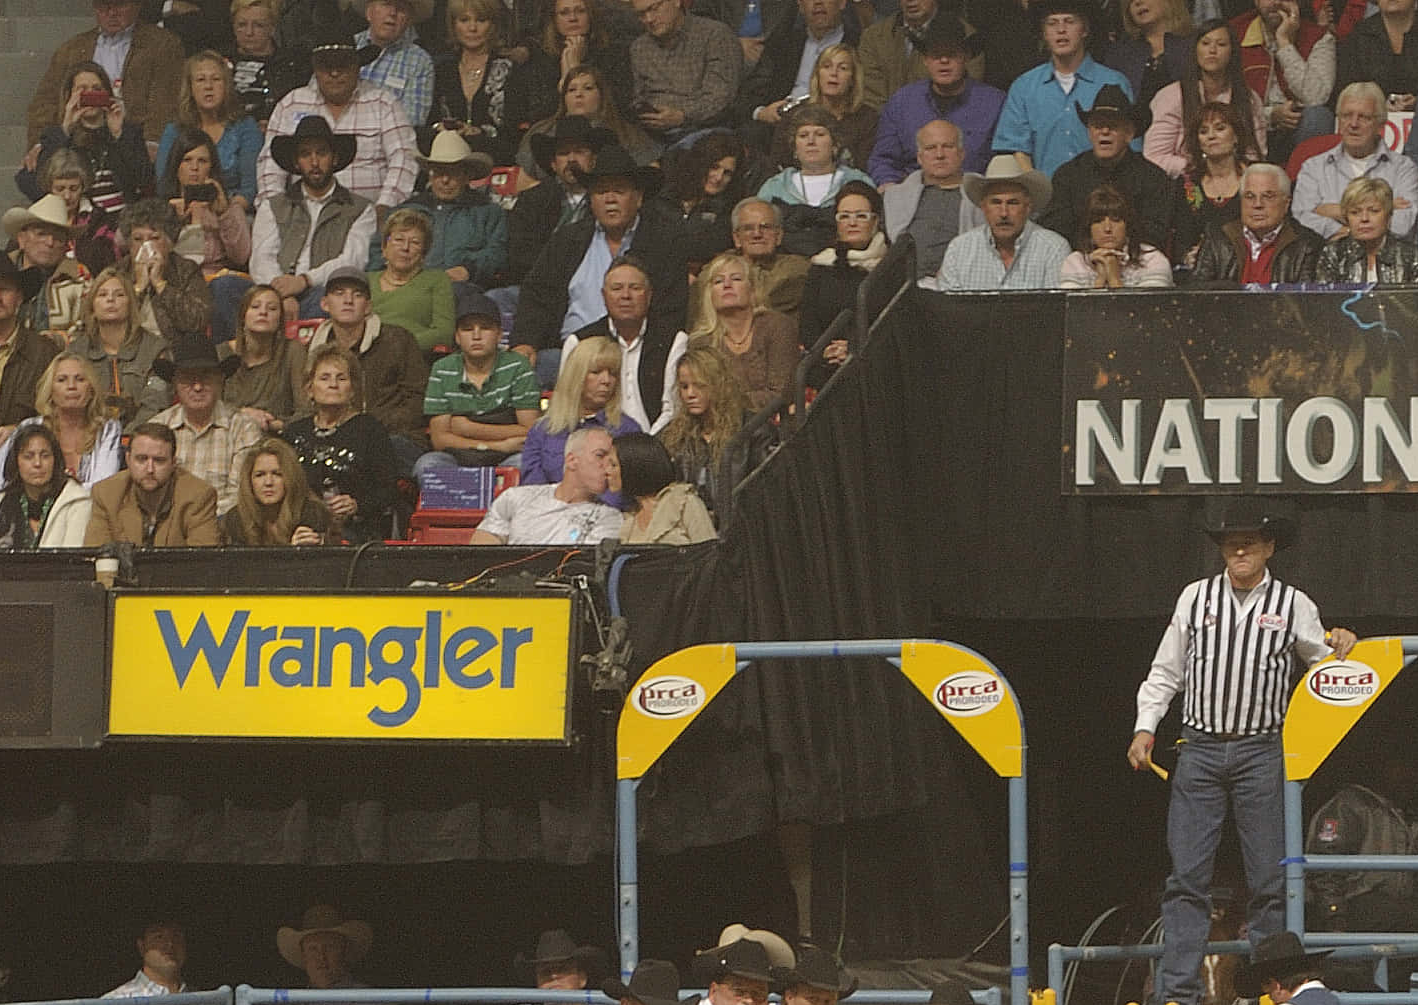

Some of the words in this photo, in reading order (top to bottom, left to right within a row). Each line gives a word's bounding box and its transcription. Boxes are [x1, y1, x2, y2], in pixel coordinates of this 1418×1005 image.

[154, 610, 534, 727] Wrangler
[941, 680, 997, 706] prca
[1314, 671, 1374, 695] prca
[1321, 686, 1374, 696] PRORODEO
[641, 684, 696, 710] prca
